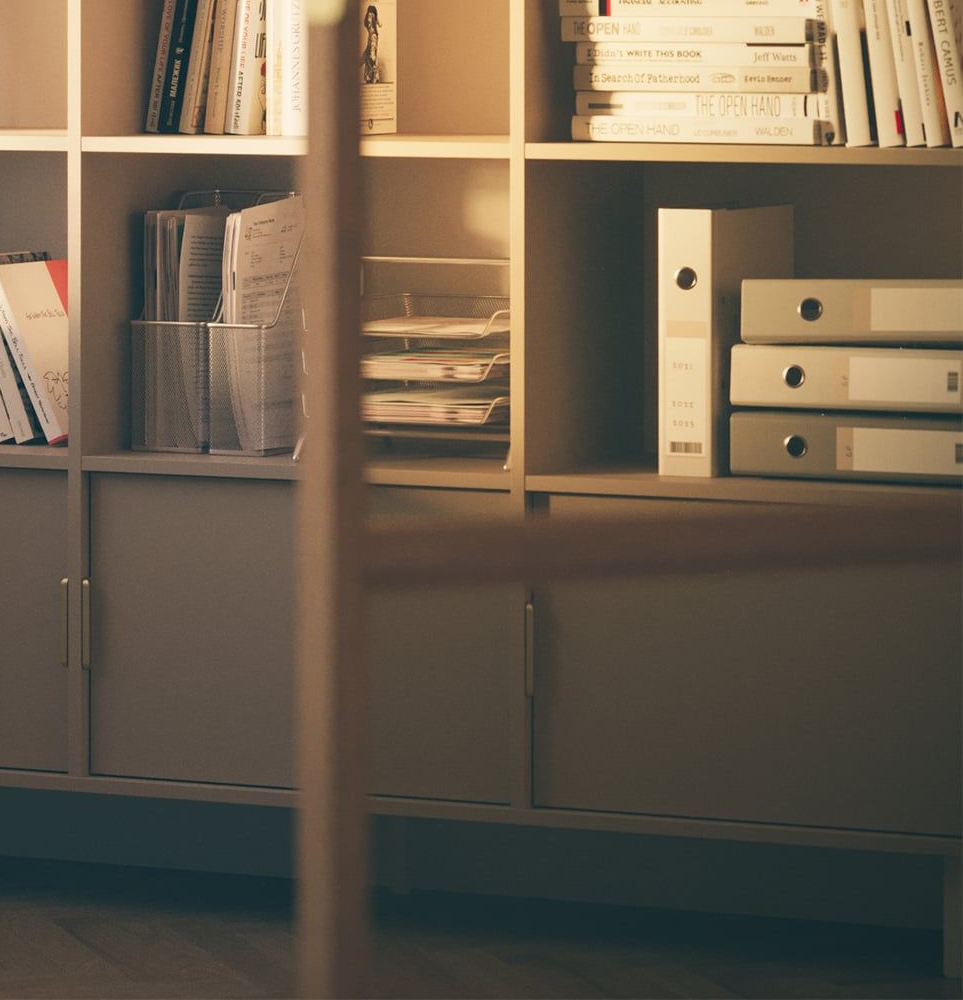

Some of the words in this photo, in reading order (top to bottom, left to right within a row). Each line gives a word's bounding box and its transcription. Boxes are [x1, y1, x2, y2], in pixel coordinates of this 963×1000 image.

[815, 4, 824, 21] WE
[573, 21, 585, 36] THE
[586, 20, 619, 36] OPEN
[622, 21, 641, 36] HAND
[754, 24, 775, 37] WALDEN
[594, 48, 624, 58] Didn't
[626, 49, 653, 59] WRITE
[655, 49, 675, 59] THIS
[676, 49, 703, 59] BOOK
[753, 51, 770, 64] Jeff
[771, 52, 797, 63] Watts
[940, 40, 958, 86] CAMUS
[589, 73, 600, 84] In
[601, 72, 634, 84] Search
[634, 73, 646, 84] Of
[647, 72, 700, 85] Fatherhood
[743, 75, 766, 84] Kevin
[695, 95, 719, 117] THE
[720, 95, 748, 117] OPEN
[751, 95, 781, 117] HAND
[585, 122, 608, 135] THE
[612, 122, 649, 136] OPEN
[652, 123, 680, 136] HAND
[755, 126, 793, 137] WALDEN
